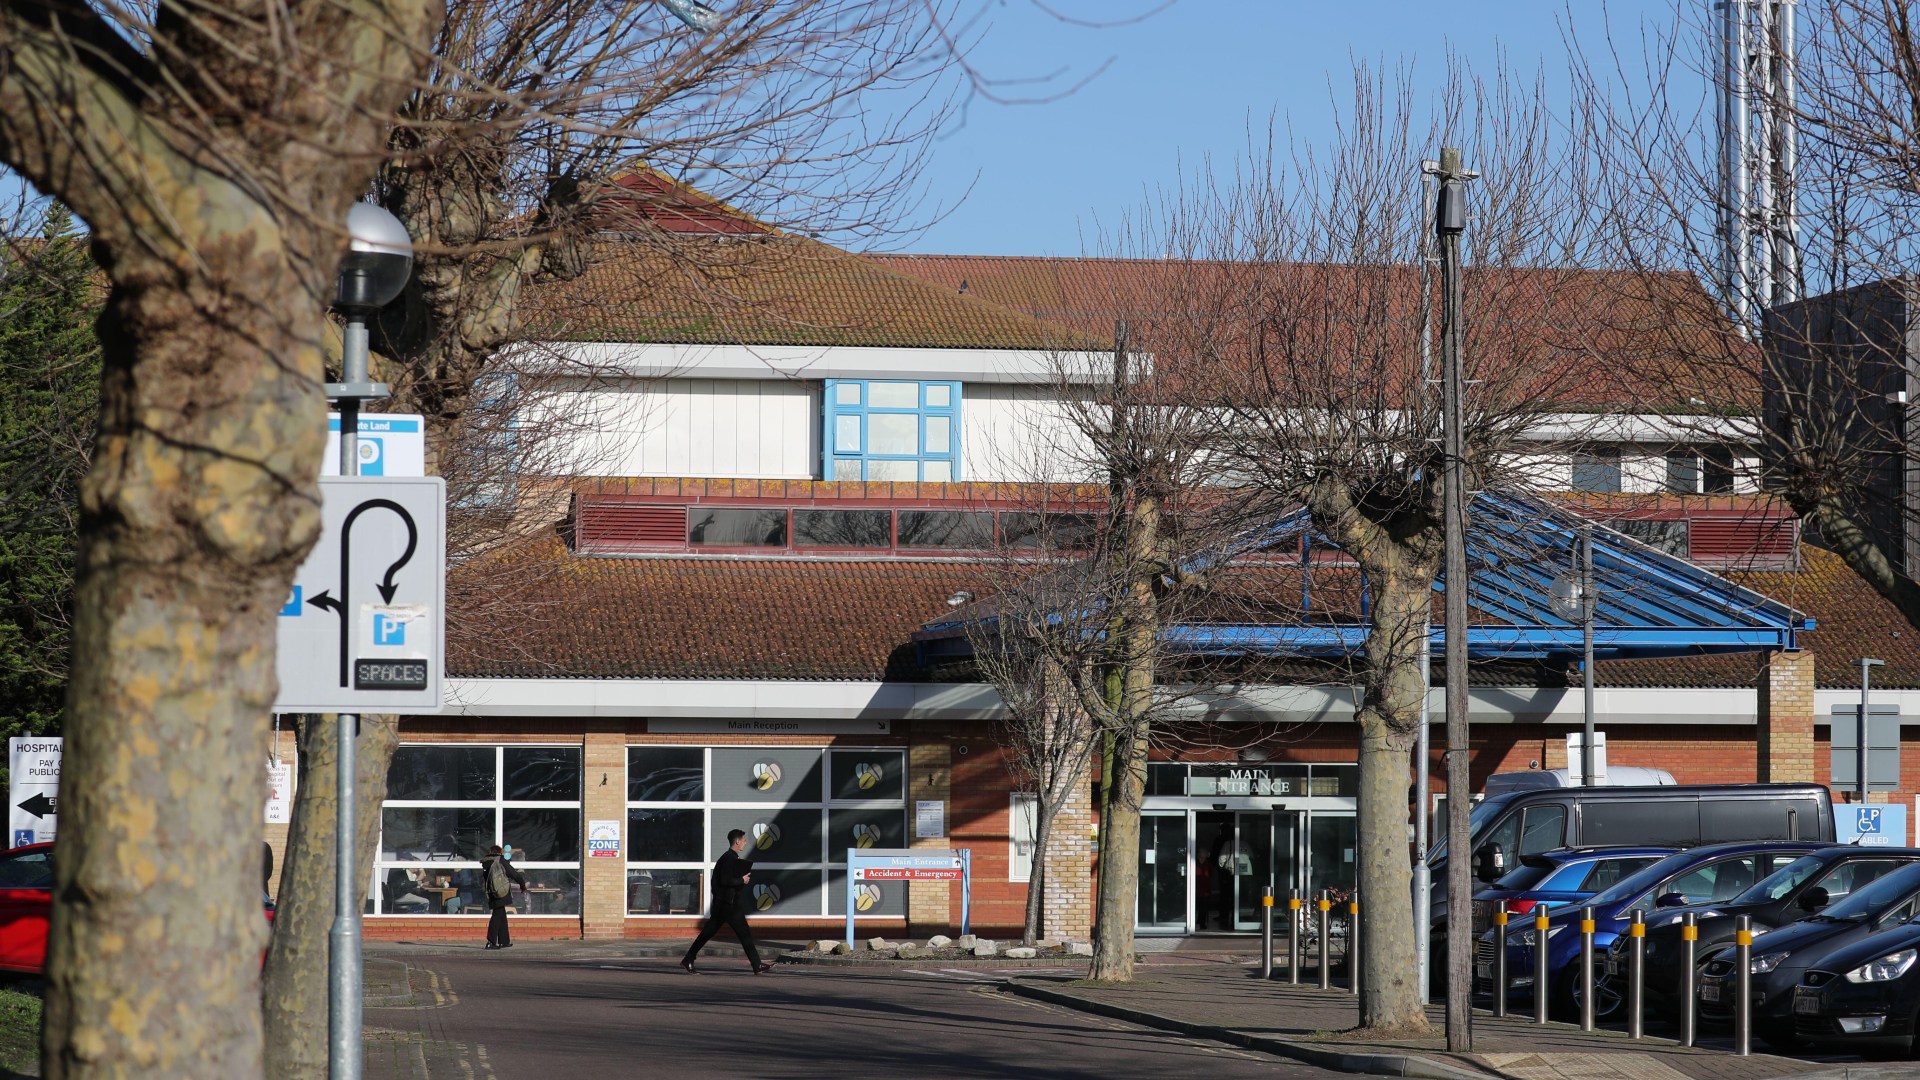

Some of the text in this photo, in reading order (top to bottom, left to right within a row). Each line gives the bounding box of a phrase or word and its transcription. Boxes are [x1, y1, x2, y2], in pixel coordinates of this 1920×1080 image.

[370, 421, 390, 430] Land
[358, 664, 425, 681] SPACES
[728, 720, 799, 732] Main Reception
[1230, 769, 1270, 779] MAIN
[1209, 782, 1290, 793] ENTRANCE
[590, 840, 618, 849] ZONE
[868, 869, 902, 877] Accident
[914, 870, 958, 879] Emergency
